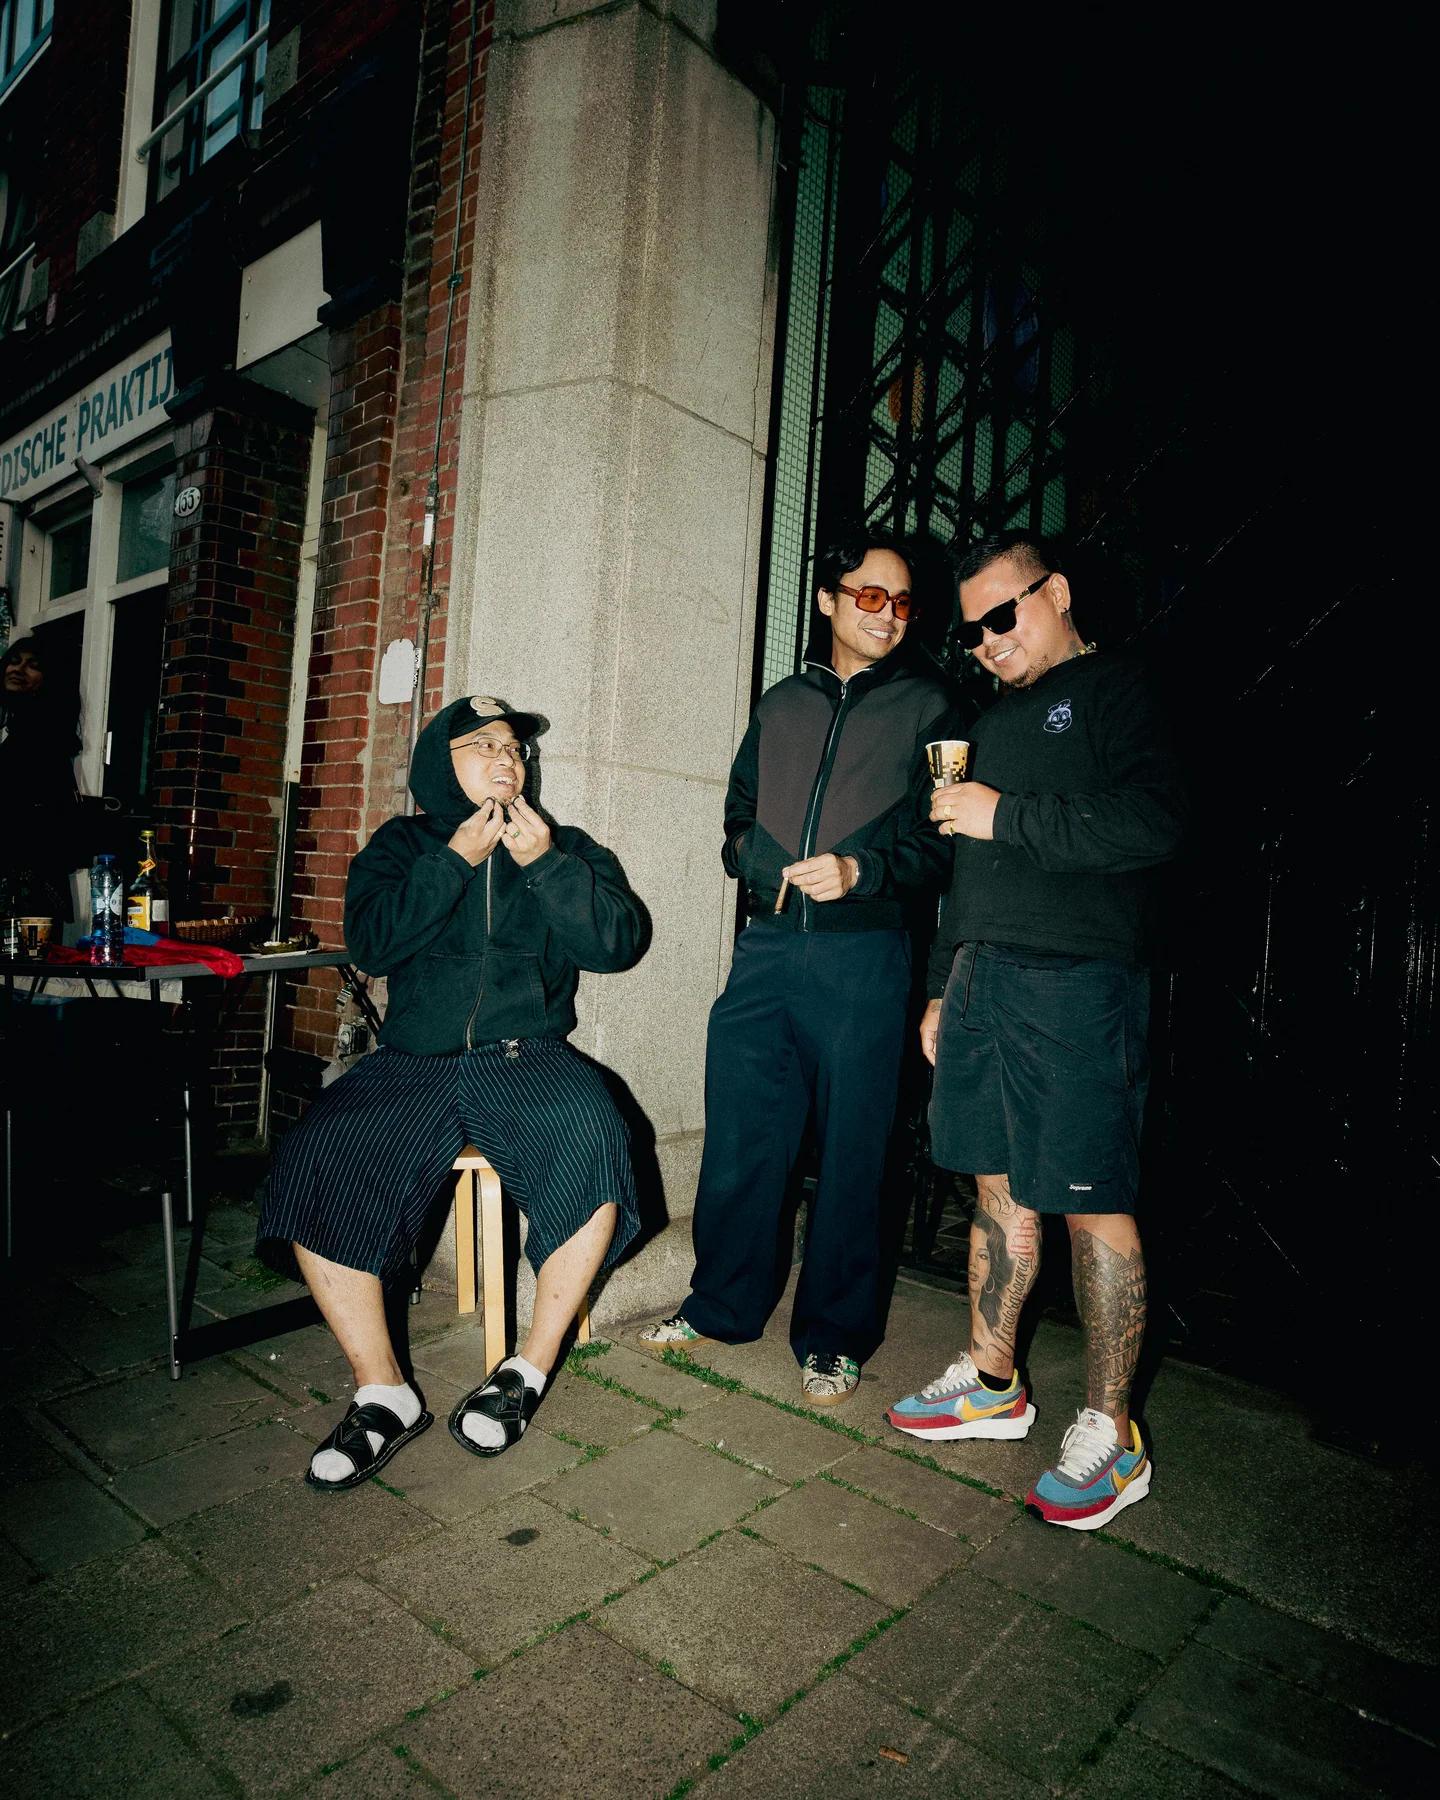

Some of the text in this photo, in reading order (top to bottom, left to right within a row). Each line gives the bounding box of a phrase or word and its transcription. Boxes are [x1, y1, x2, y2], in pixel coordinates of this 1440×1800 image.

[0, 346, 179, 497] DISCHE PRAKTIJ
[178, 489, 196, 514] 155
